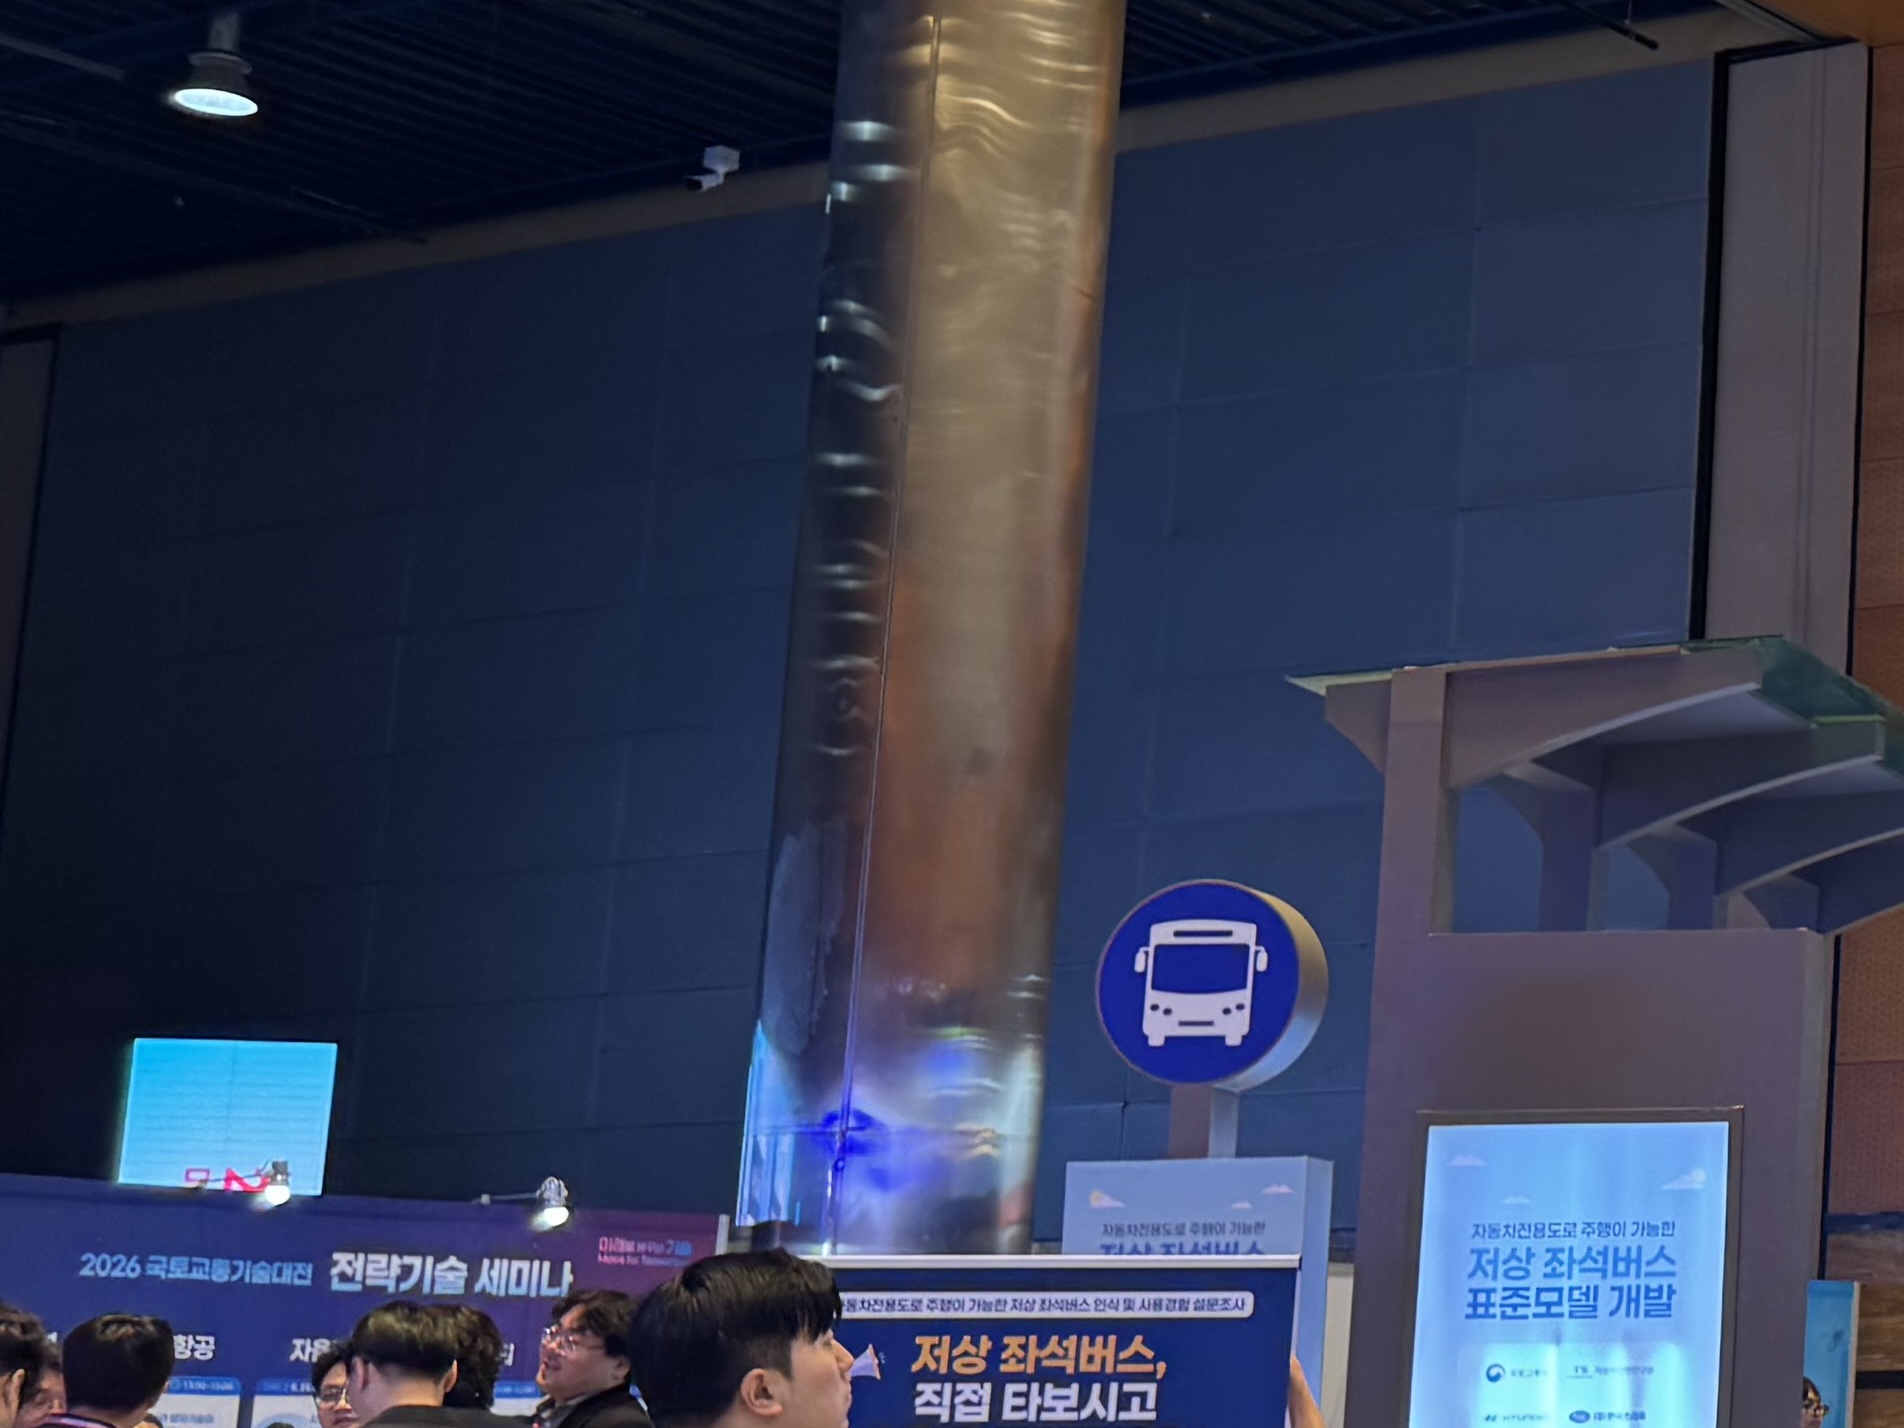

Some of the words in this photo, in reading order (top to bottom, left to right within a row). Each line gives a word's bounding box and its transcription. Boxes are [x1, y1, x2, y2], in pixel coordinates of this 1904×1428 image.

[1101, 1222, 1187, 1238] 자동차전용도로
[1581, 1221, 1627, 1238] 주행이
[1630, 1220, 1676, 1238] 가능한
[79, 1252, 141, 1278] 2026
[145, 1254, 314, 1286] 국토교통기술대전
[330, 1251, 468, 1294] 전략기술
[474, 1257, 574, 1297] 세미나
[1467, 1246, 1536, 1281] 저상
[1543, 1244, 1677, 1280] 좌석버스
[841, 1297, 924, 1313] 동차전용도로
[1009, 1297, 1037, 1312] 저상
[1038, 1296, 1091, 1313] 좌석버스
[1093, 1296, 1121, 1313] 인식
[1122, 1296, 1136, 1312] 및
[1465, 1284, 1600, 1320] 표준모델
[1608, 1283, 1677, 1319] 개발
[911, 1335, 990, 1374] 저상
[1000, 1336, 1167, 1379] 좌석버스,
[914, 1382, 990, 1422] 직접
[1001, 1382, 1158, 1421] 타보시고
